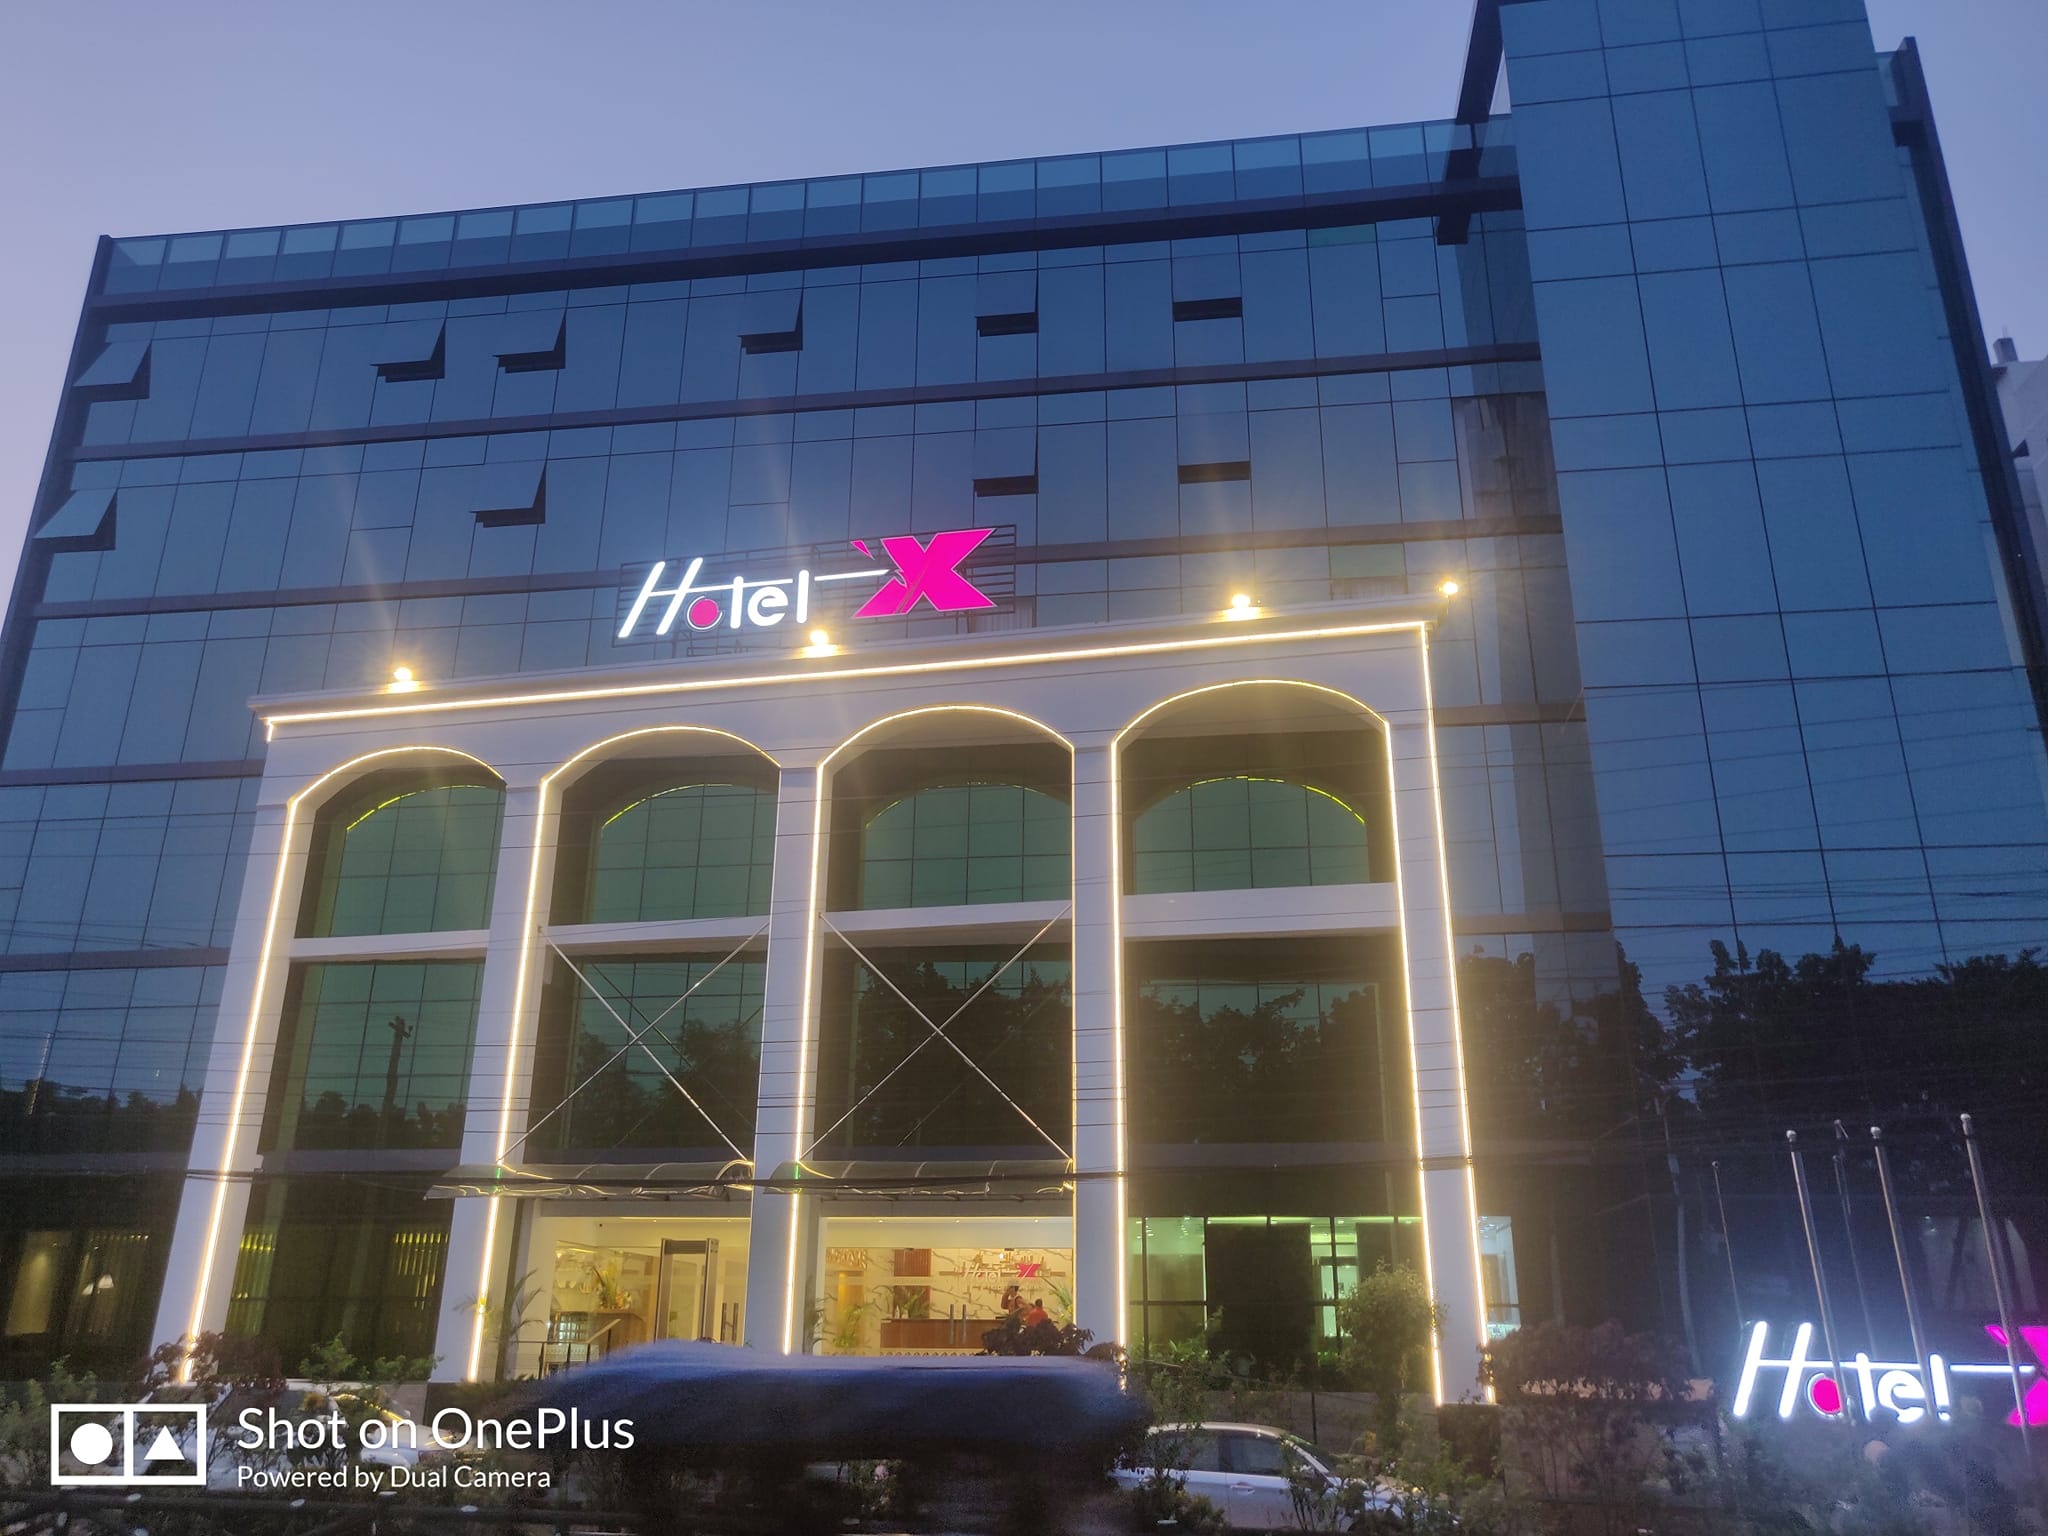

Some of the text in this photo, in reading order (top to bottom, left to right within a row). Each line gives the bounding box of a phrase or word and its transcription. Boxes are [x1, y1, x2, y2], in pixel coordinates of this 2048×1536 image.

[618, 528, 998, 638] Hotel X
[963, 1262, 1001, 1280] Hotel
[1732, 1320, 1950, 1423] Hotel
